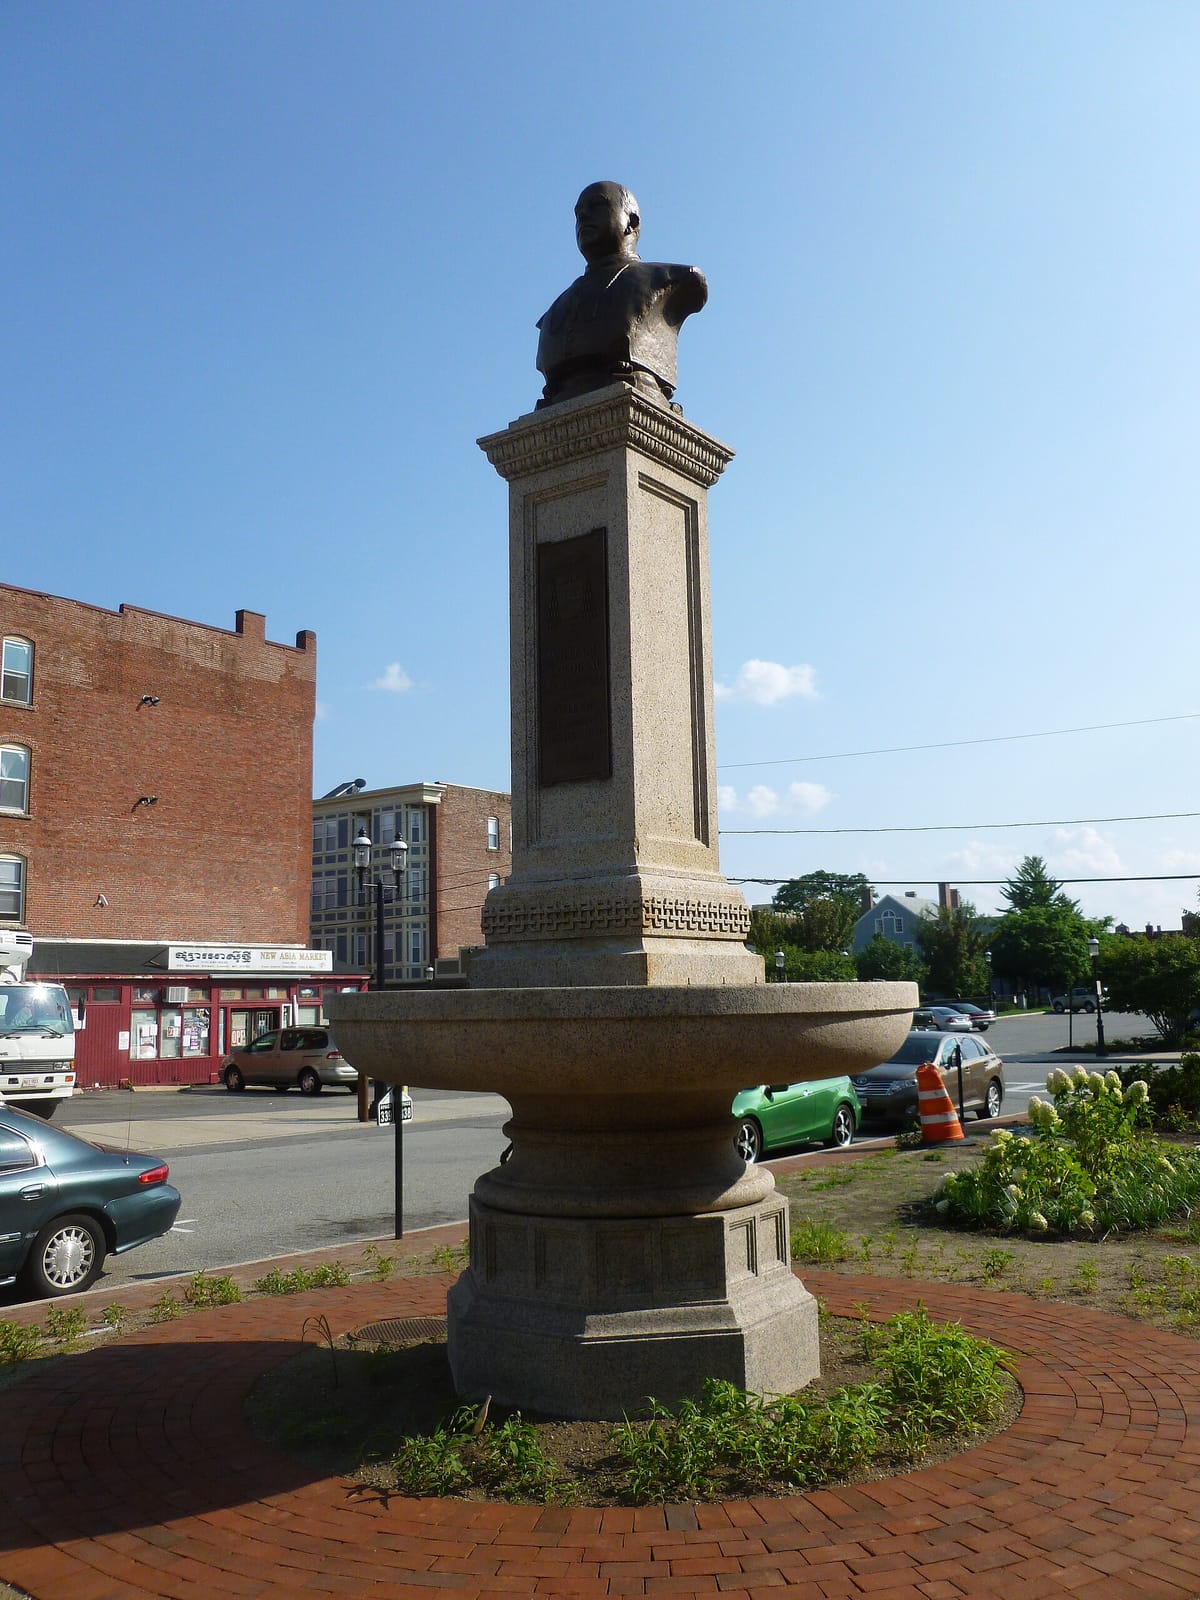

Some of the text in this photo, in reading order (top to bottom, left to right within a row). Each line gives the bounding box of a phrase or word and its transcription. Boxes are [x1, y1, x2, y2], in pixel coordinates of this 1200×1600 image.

[260, 951, 327, 961] NEW ASIA MARKET
